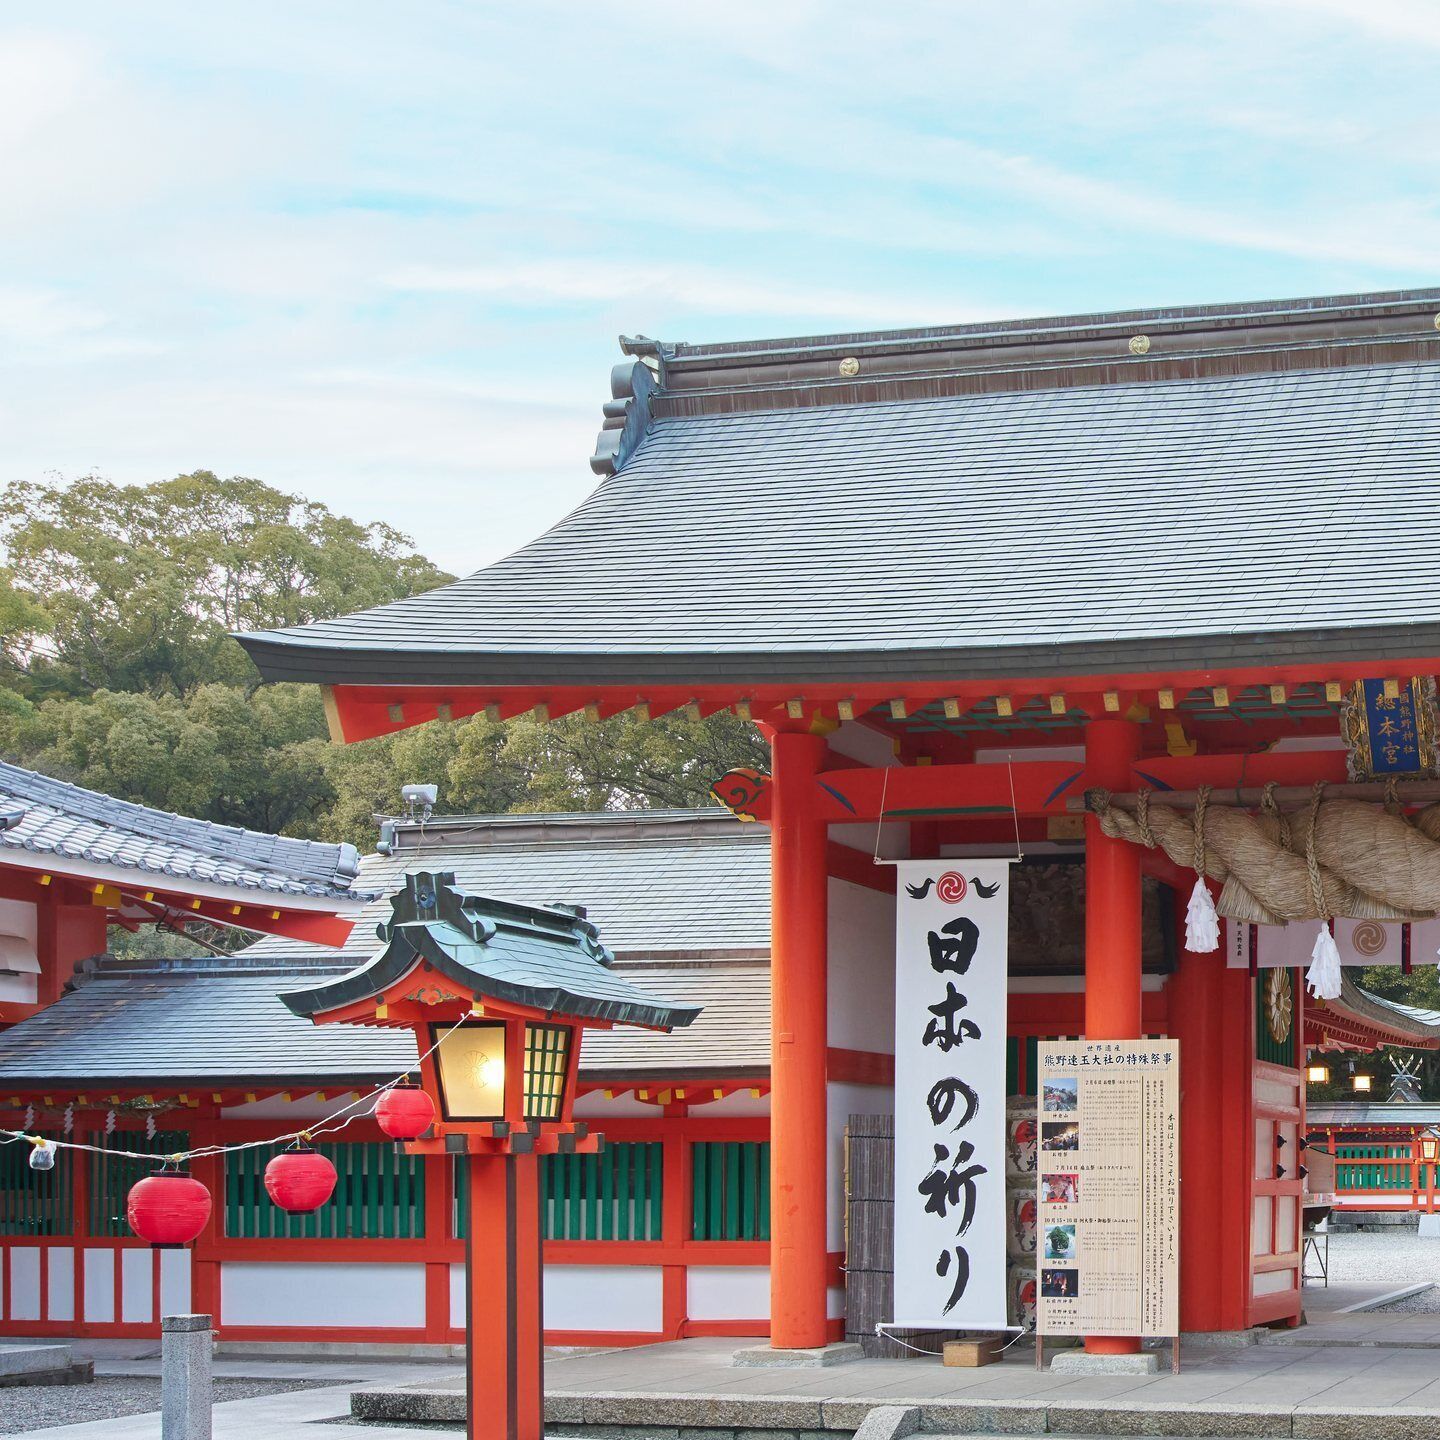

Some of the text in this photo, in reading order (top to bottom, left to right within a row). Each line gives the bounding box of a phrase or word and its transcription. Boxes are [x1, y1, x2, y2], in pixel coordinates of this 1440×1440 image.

[918, 916, 987, 1317] 日本の祈り
[1044, 1052, 1173, 1067] 熊野速玉大社の特殊祭事
